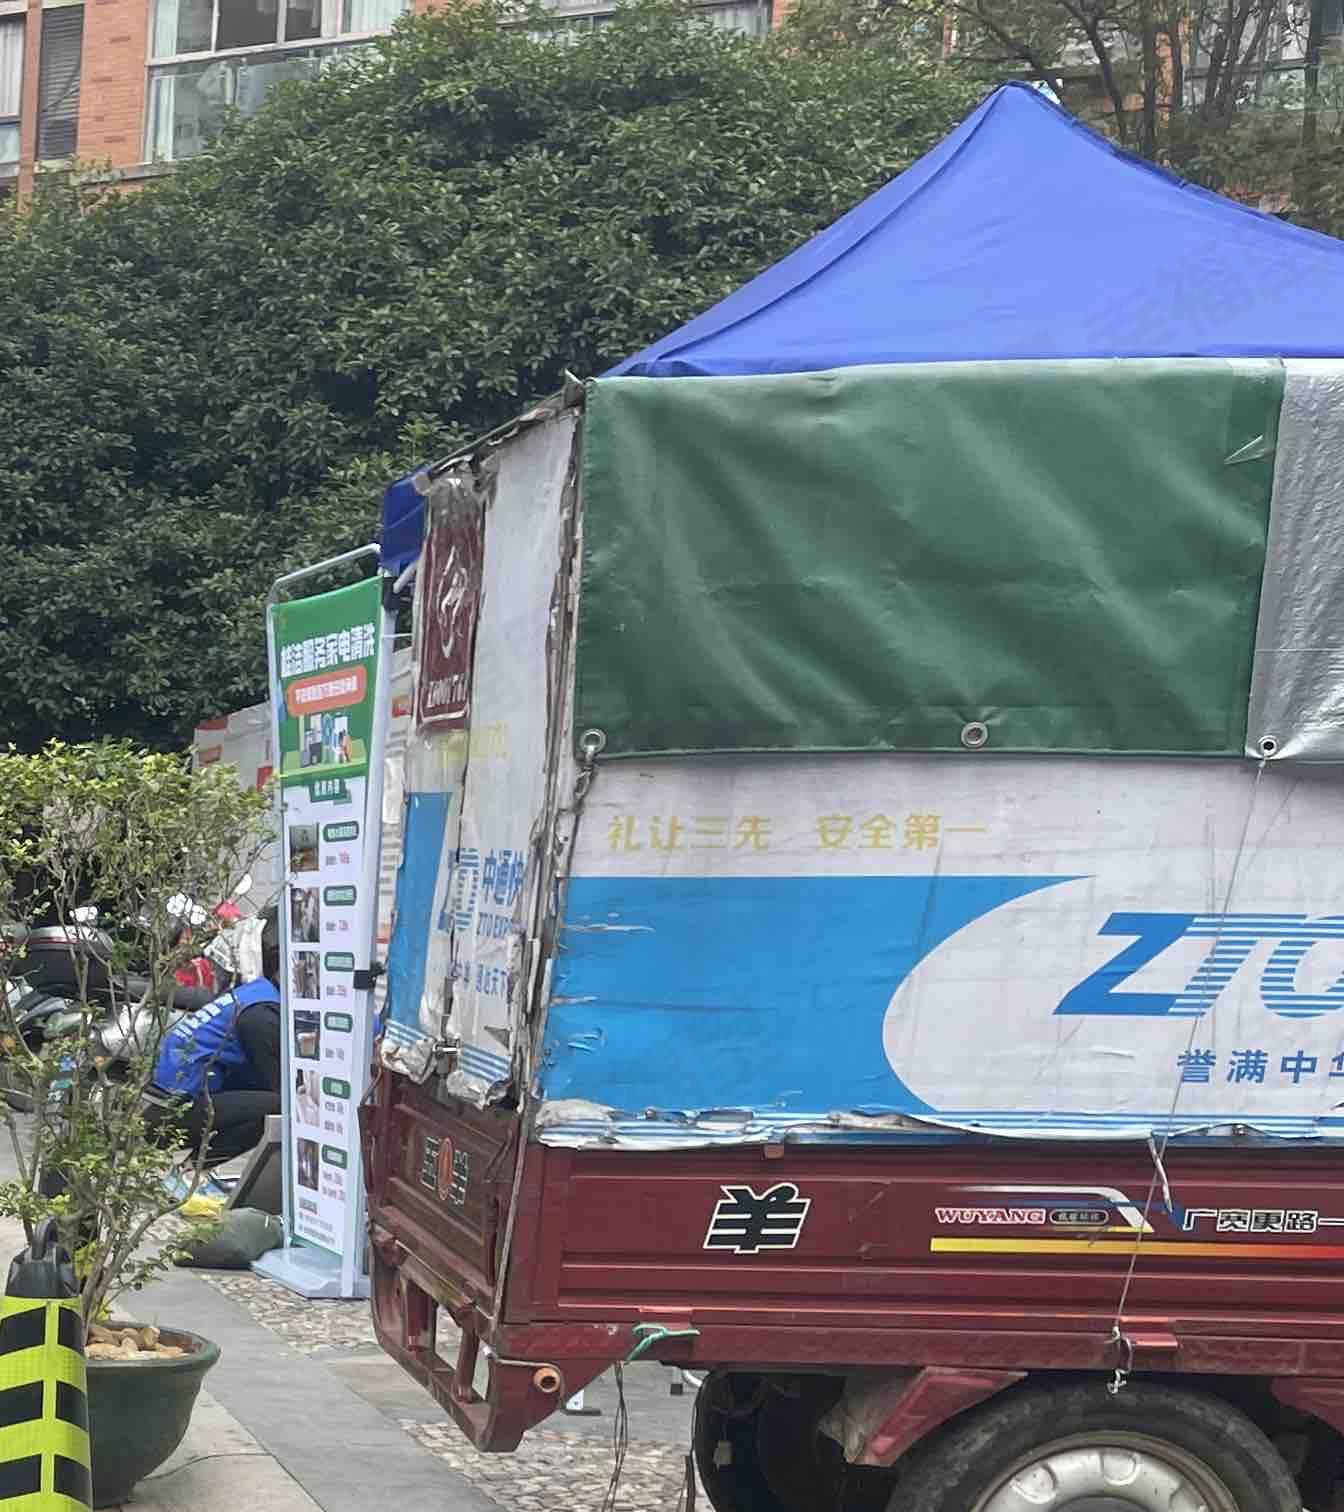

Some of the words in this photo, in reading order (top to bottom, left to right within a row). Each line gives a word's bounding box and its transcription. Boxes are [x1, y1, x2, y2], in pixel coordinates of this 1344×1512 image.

[608, 814, 772, 851] 礼让三先
[816, 813, 988, 850] 安全第一
[703, 1182, 812, 1254] 羊
[934, 1207, 1046, 1225] WUYANG
